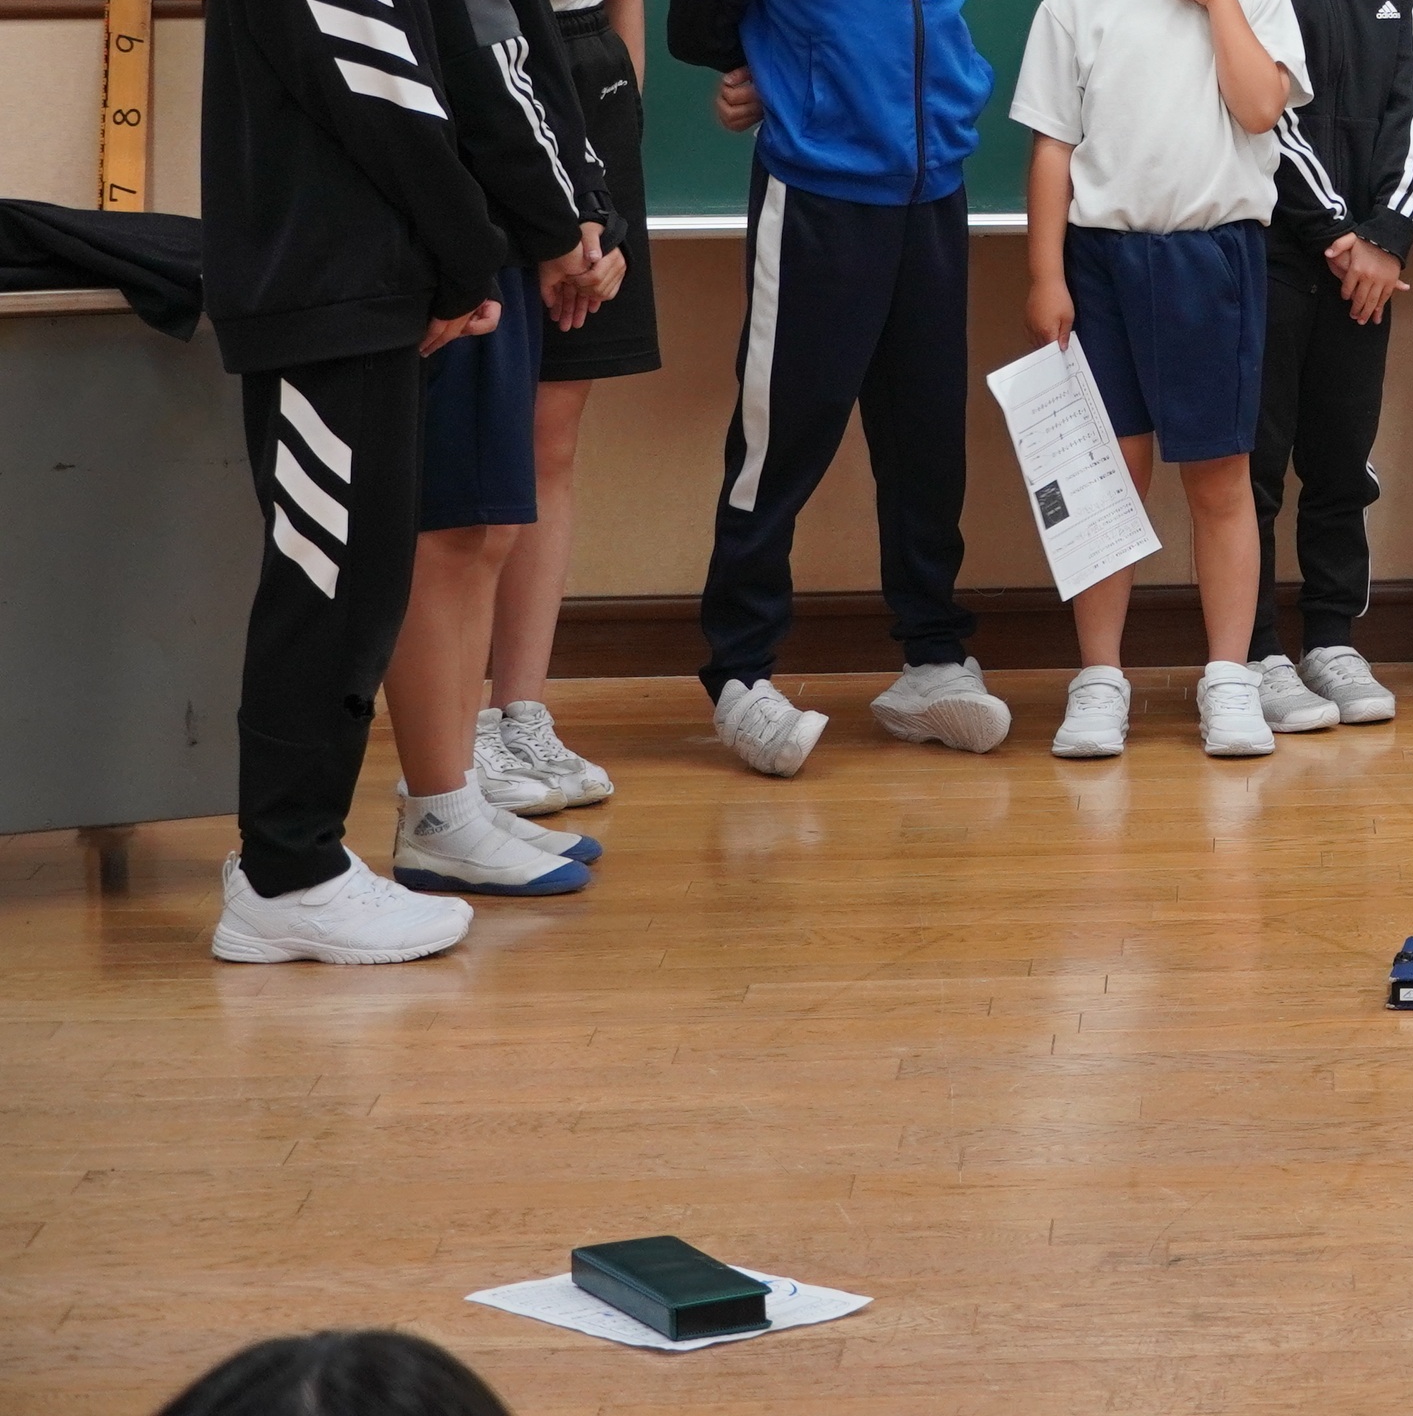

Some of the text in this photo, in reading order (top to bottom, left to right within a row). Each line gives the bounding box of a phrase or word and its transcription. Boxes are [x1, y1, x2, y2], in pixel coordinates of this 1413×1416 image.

[1376, 12, 1401, 20] adidas
[115, 34, 144, 53] 9
[112, 108, 141, 127] 8
[109, 183, 137, 202] 7
